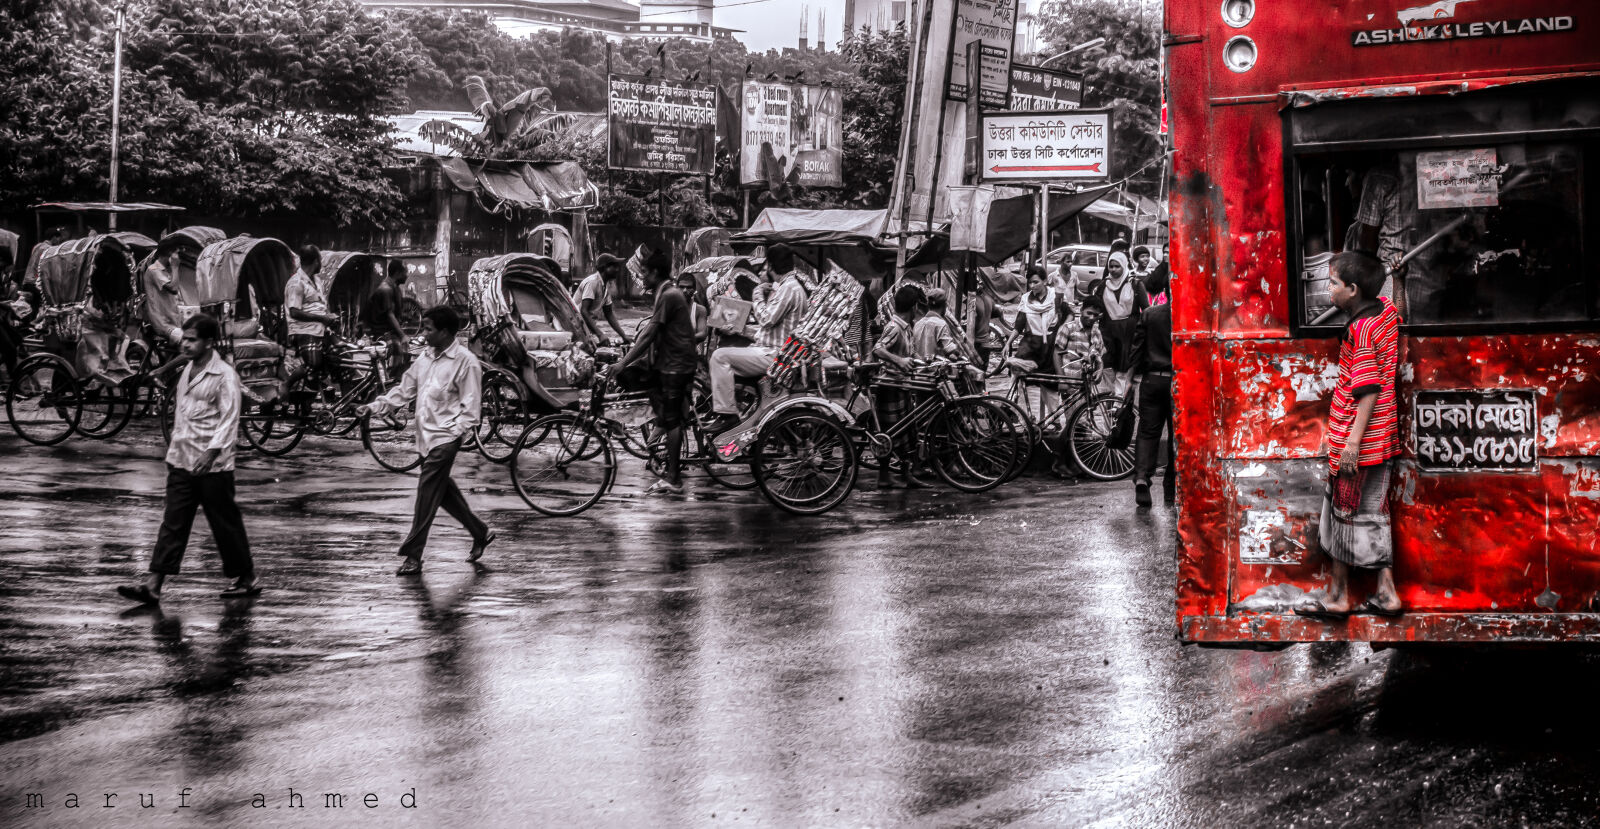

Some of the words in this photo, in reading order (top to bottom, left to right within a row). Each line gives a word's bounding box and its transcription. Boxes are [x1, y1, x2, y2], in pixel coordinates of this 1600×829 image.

[1456, 16, 1573, 37] LEYLAND
[610, 90, 639, 117] ক্রিসেন্ট
[640, 96, 682, 121] কমার্শিয়াল
[682, 97, 705, 123] সেন্টার
[988, 121, 1015, 141] উত্তরা
[1019, 120, 1066, 141] কমিউনিটি
[1070, 120, 1103, 140] সেন্টার
[987, 148, 1008, 160] ঢাকা
[1011, 146, 1031, 159] উত্তর
[1035, 145, 1054, 159] সিটি
[1057, 144, 1104, 159] কর্পোরেশন
[804, 160, 830, 172] BORAK
[1417, 399, 1474, 430] ঢাকা
[1475, 393, 1533, 433] মেট্রো
